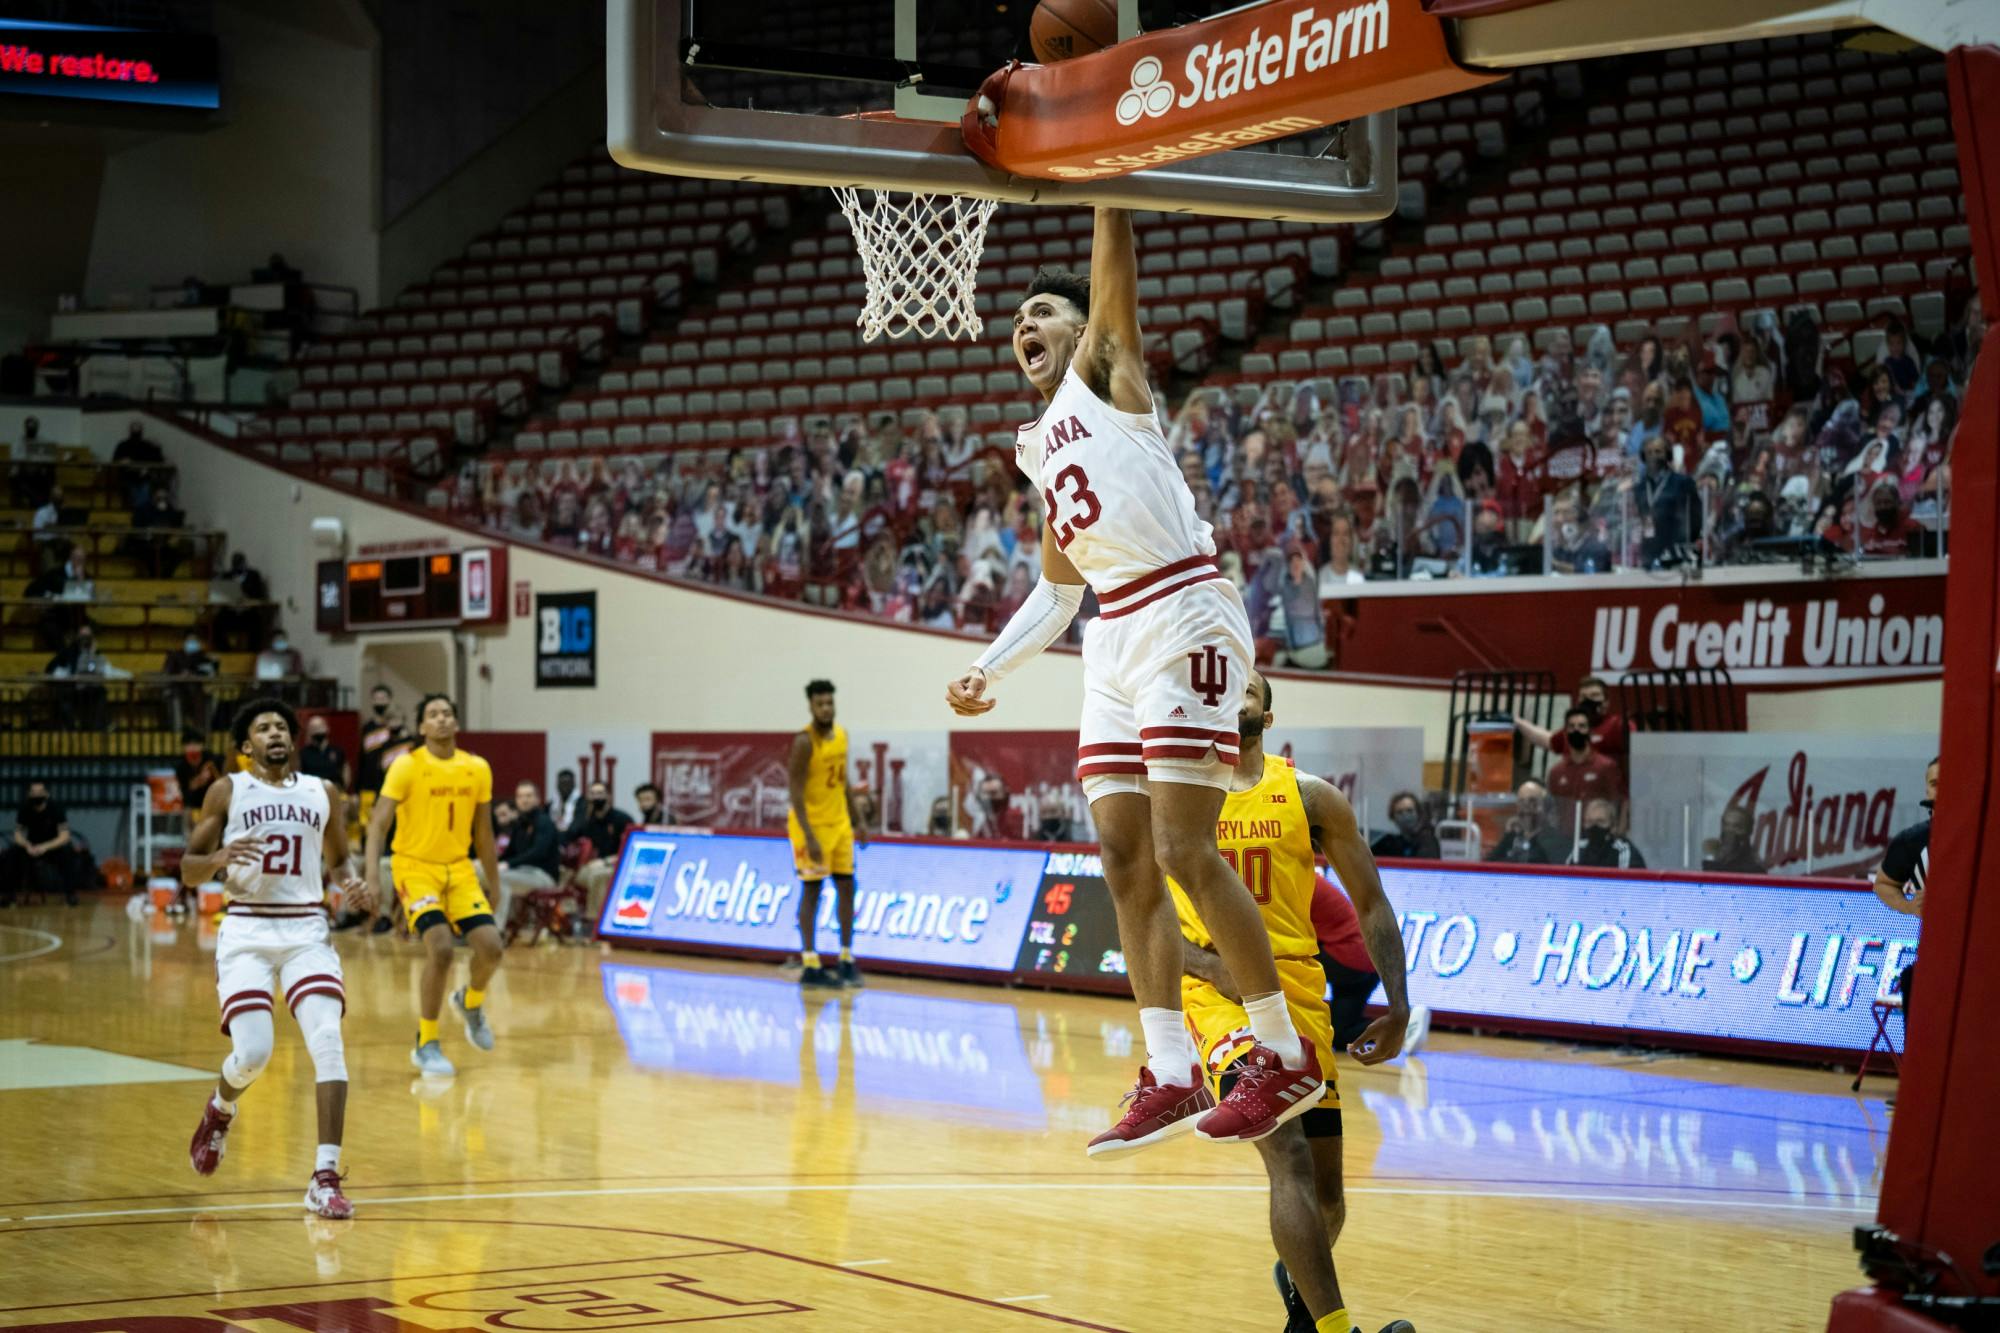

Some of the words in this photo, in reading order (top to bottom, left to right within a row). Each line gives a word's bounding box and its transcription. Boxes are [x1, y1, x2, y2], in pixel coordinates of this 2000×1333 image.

[0, 44, 44, 73] We
[1045, 463, 1102, 552] 23
[1591, 606, 1640, 668] IU
[1649, 599, 1791, 668] Credit
[1801, 593, 1943, 667] Union
[242, 804, 321, 831] INDIANA
[447, 802, 455, 832] 1
[1216, 819, 1282, 840] RYLAND
[1721, 751, 1896, 870] Indiana
[262, 834, 303, 876] 21
[666, 858, 791, 924] Shelter
[820, 886, 989, 942] urance
[1044, 883, 1075, 914] 45
[1397, 911, 1477, 976] TO
[1532, 920, 1719, 998] HOME
[1776, 932, 1918, 1006] LIFE
